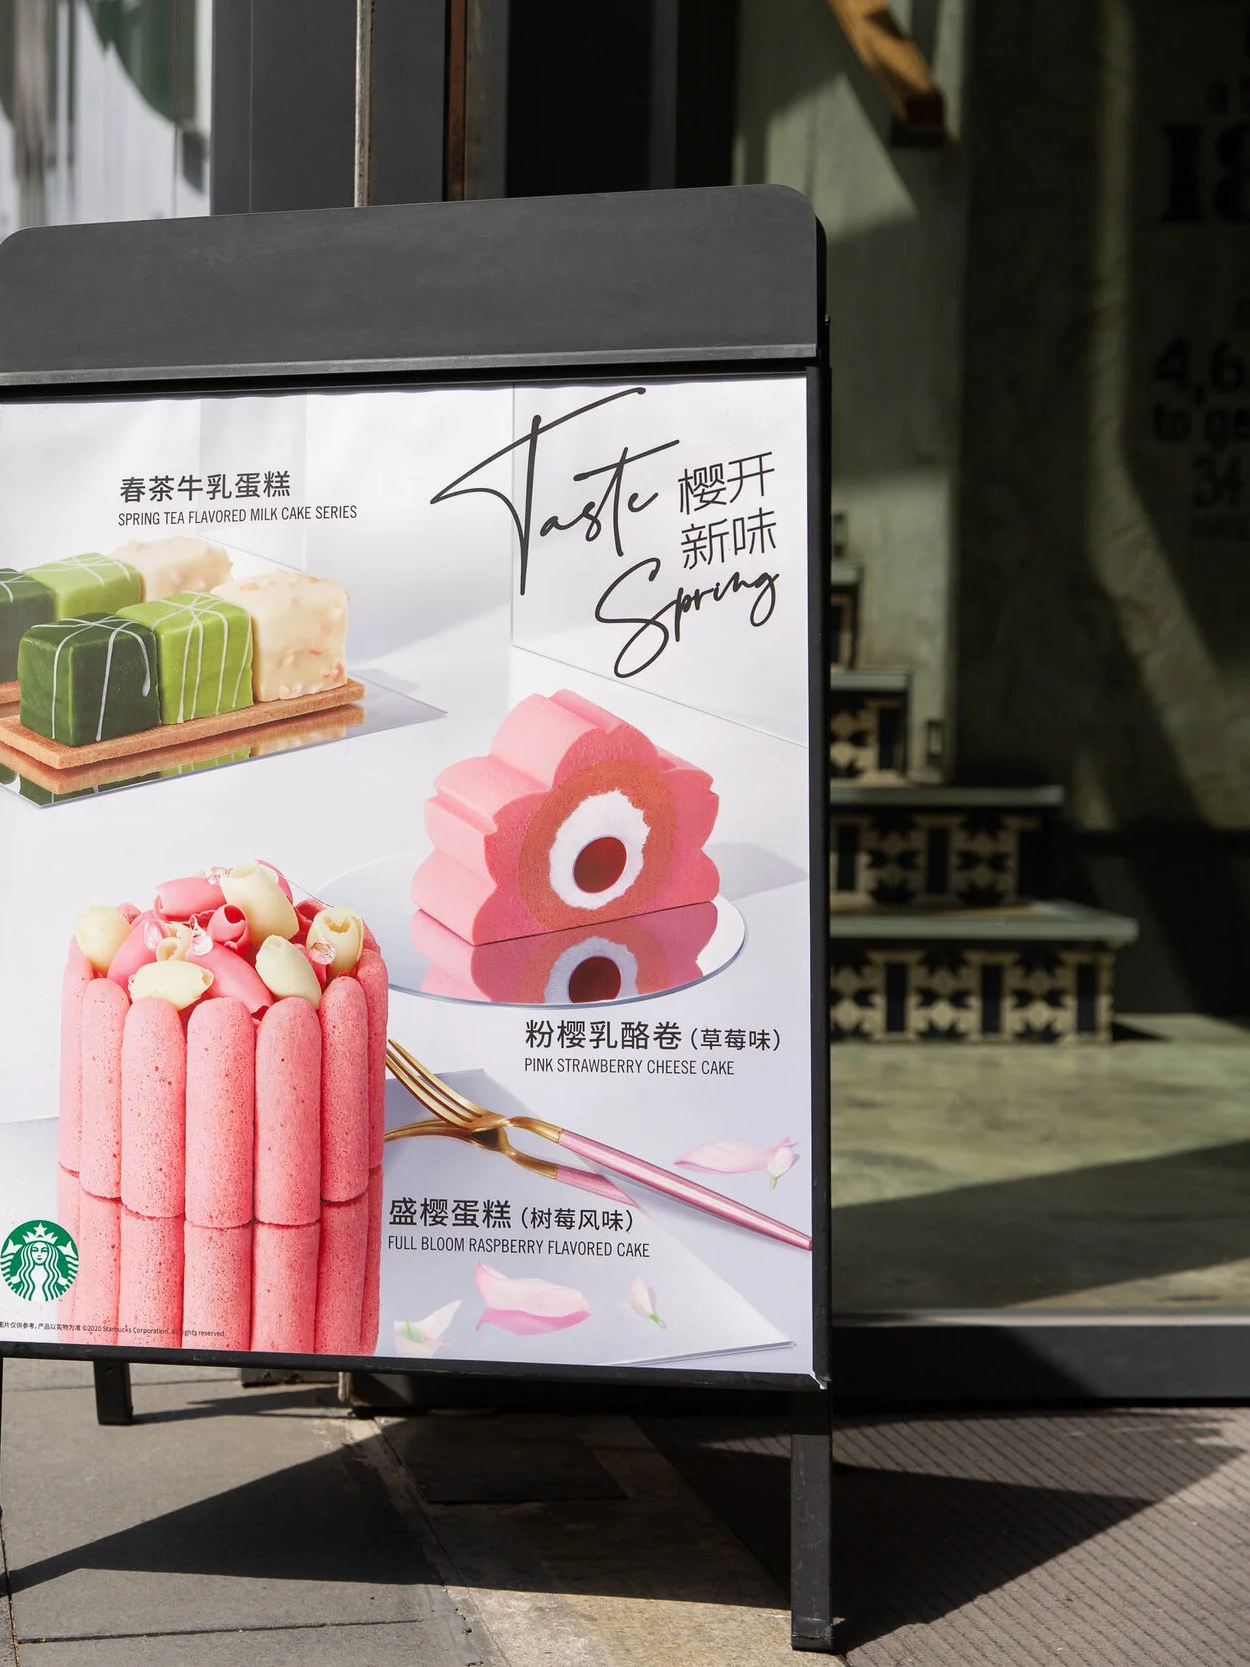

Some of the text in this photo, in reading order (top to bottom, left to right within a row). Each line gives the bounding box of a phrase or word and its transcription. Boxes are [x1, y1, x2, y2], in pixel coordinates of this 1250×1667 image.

[120, 470, 291, 503] 春茶牛乳蛋糕
[430, 387, 680, 595] Taste
[678, 452, 776, 515] 樱开
[118, 505, 357, 526] SPRING TEA FLAVORED MILK CAKE SERIES
[681, 507, 777, 570] 新味
[595, 557, 780, 678] Spring
[524, 1058, 735, 1075] PINK STRAWBERRY CHEESE CAKE
[388, 1235, 650, 1258] FULL BLOOM RASPBERRY FLAVORED CAKE
[102, 1325, 132, 1333] Starbucks
